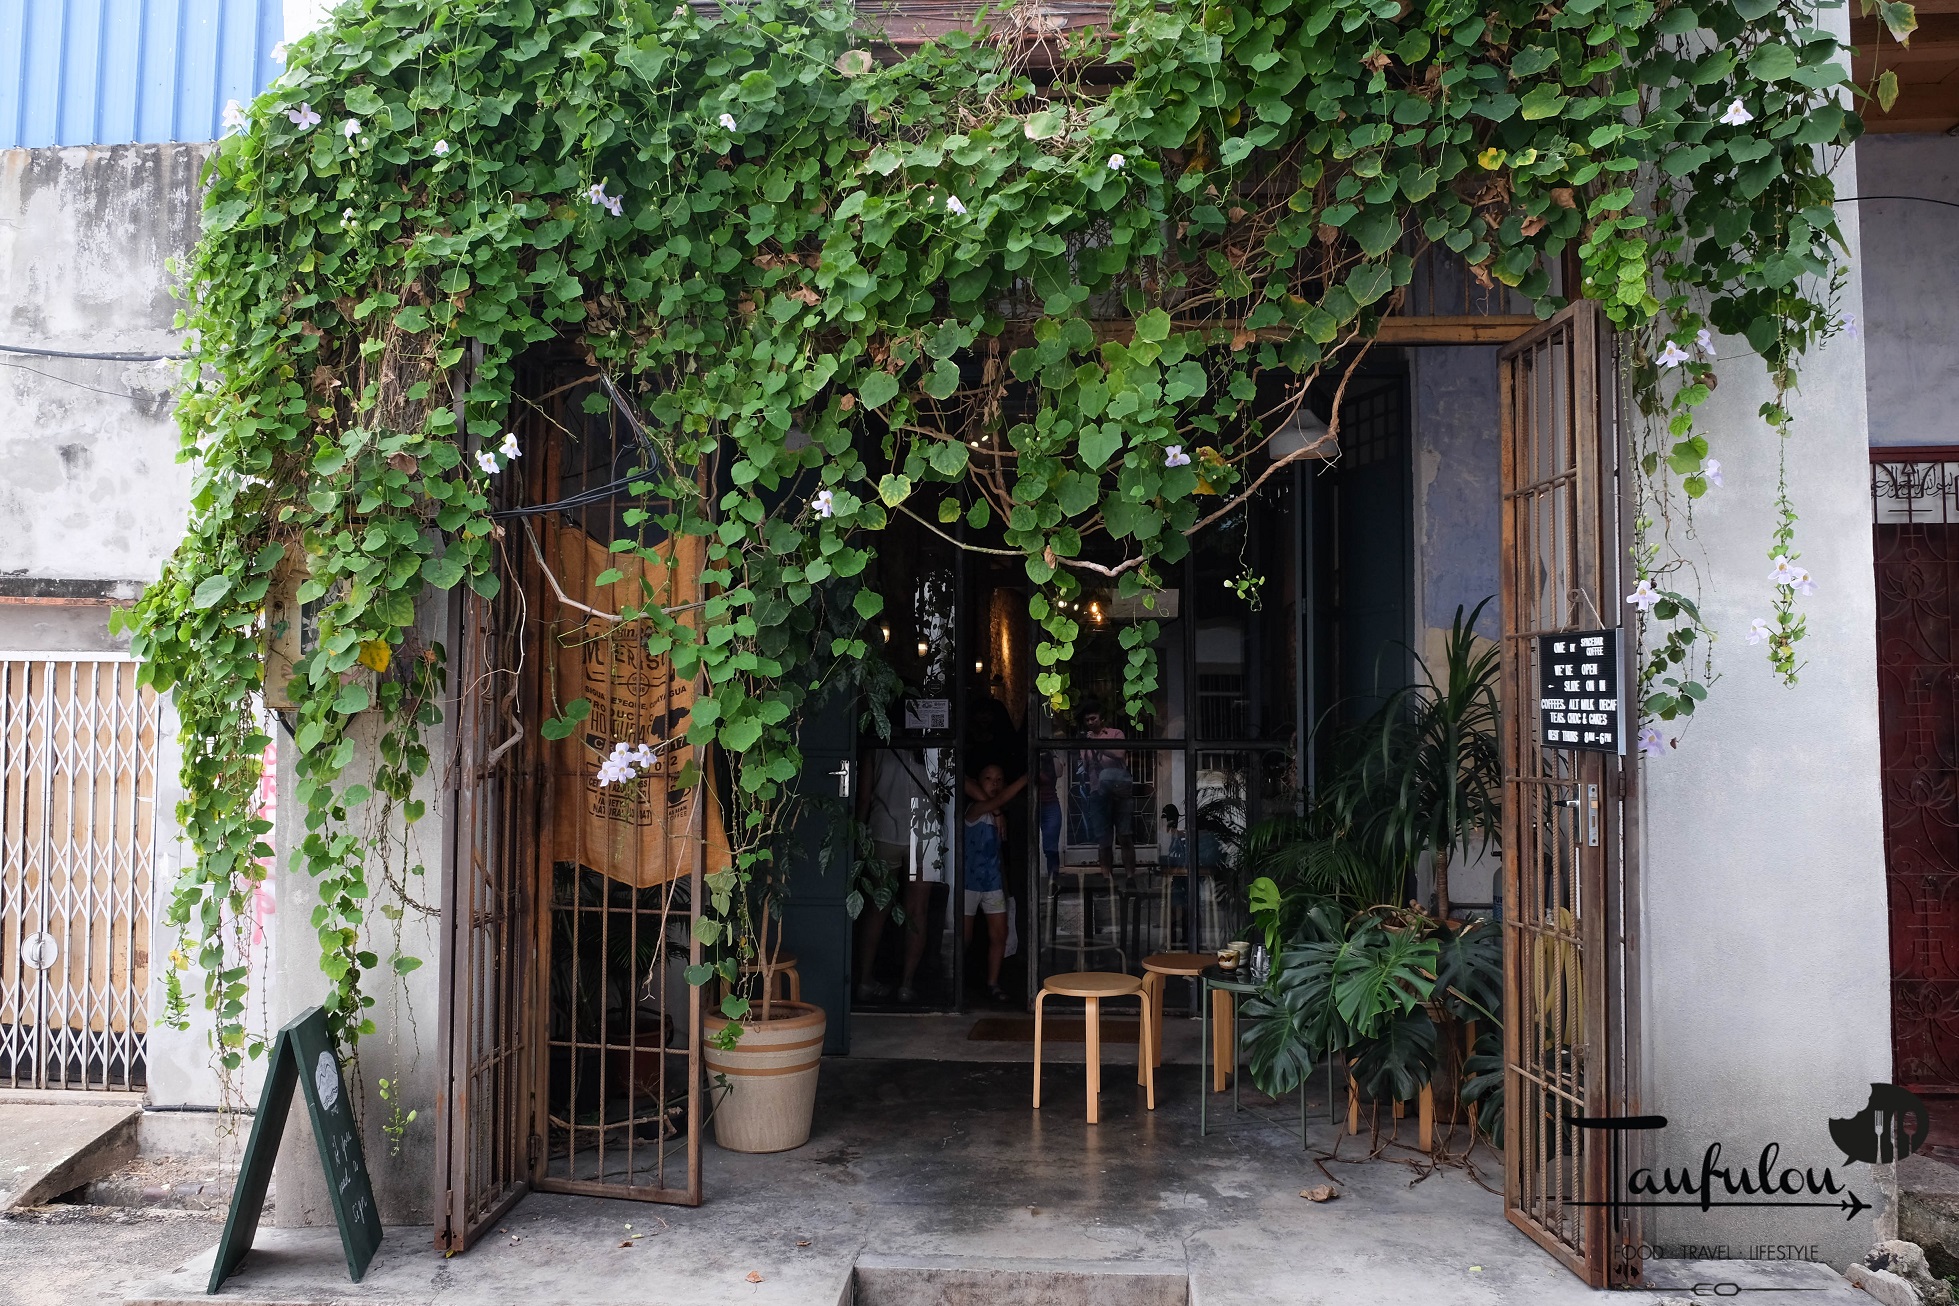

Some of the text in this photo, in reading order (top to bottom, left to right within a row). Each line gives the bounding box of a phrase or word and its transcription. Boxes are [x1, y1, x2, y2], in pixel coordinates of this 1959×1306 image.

[1586, 647, 1604, 656] COFFEE
[1581, 664, 1598, 675] OPEN
[1564, 681, 1580, 691] SLIDE
[1586, 680, 1595, 691] ON
[1569, 699, 1579, 710] ALT
[1581, 699, 1595, 710] MILK
[1599, 699, 1617, 711] DECAF
[1567, 713, 1581, 724] CHOC
[1582, 713, 1588, 724] &
[1589, 714, 1608, 725] CAKES
